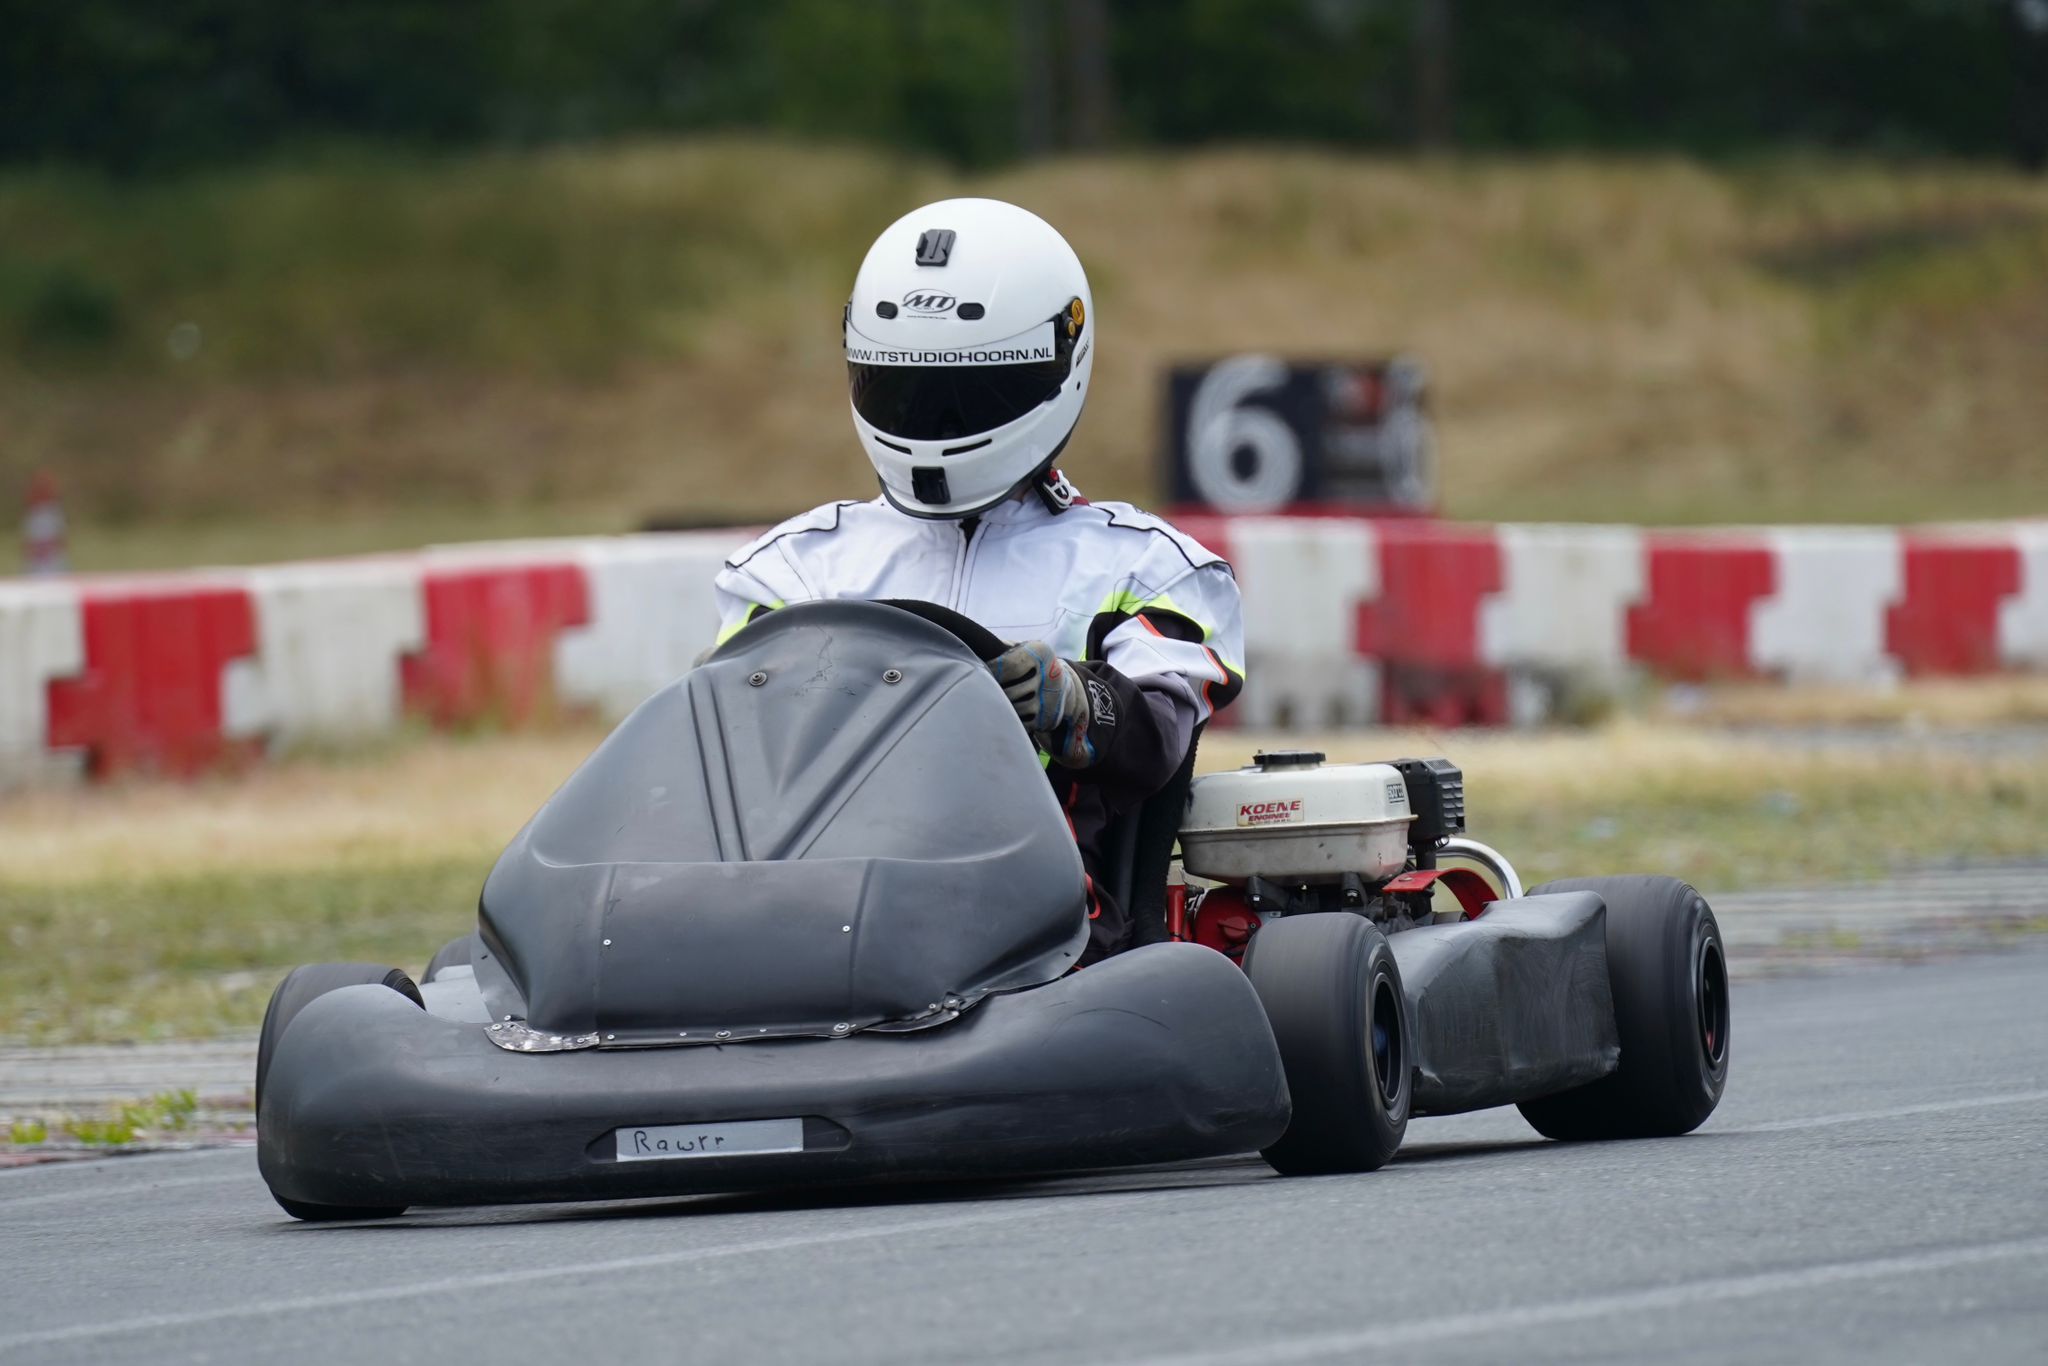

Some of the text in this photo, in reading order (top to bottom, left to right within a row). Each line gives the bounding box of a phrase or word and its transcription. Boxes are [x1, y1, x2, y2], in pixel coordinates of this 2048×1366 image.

[902, 295, 956, 308] MT
[1187, 353, 1302, 515] 6
[1240, 800, 1301, 816] KOENE
